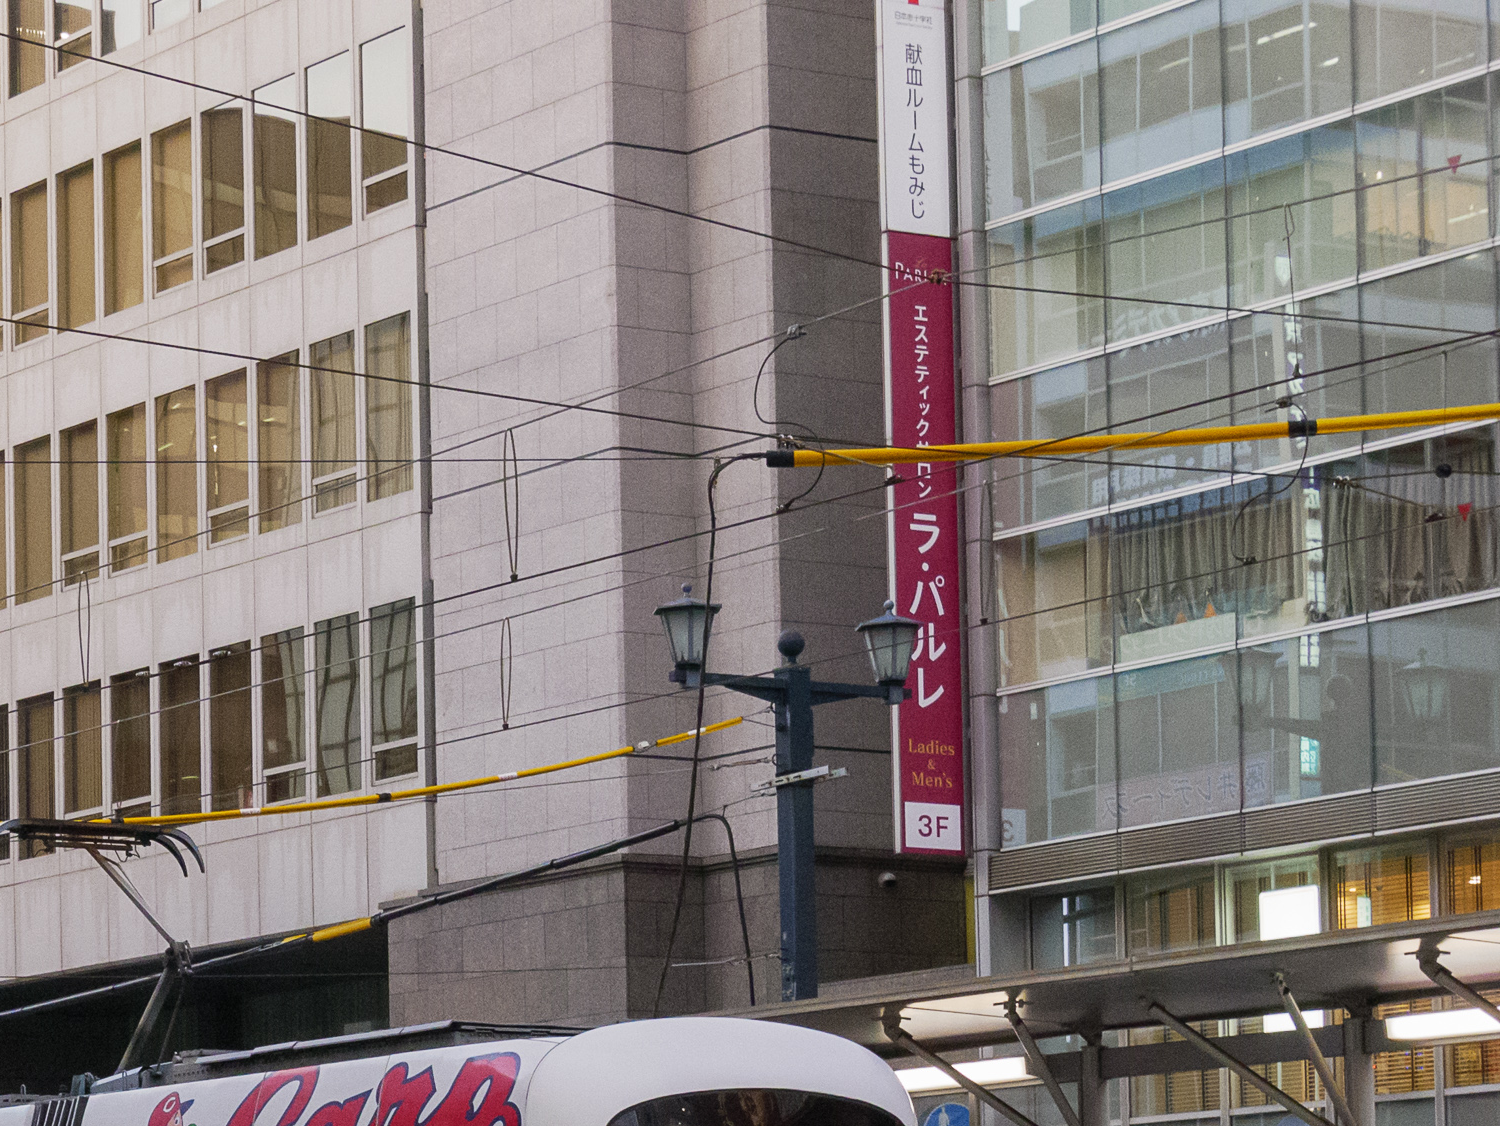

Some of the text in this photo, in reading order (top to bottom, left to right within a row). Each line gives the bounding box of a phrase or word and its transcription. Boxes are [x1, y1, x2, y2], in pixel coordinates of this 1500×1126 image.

[905, 43, 925, 219] 献血ルームもみじ
[909, 513, 947, 708] ラ・パルレ
[908, 738, 955, 756] Ladies
[927, 759, 936, 770] &
[912, 771, 953, 789] Men's
[918, 814, 949, 838] 3F
